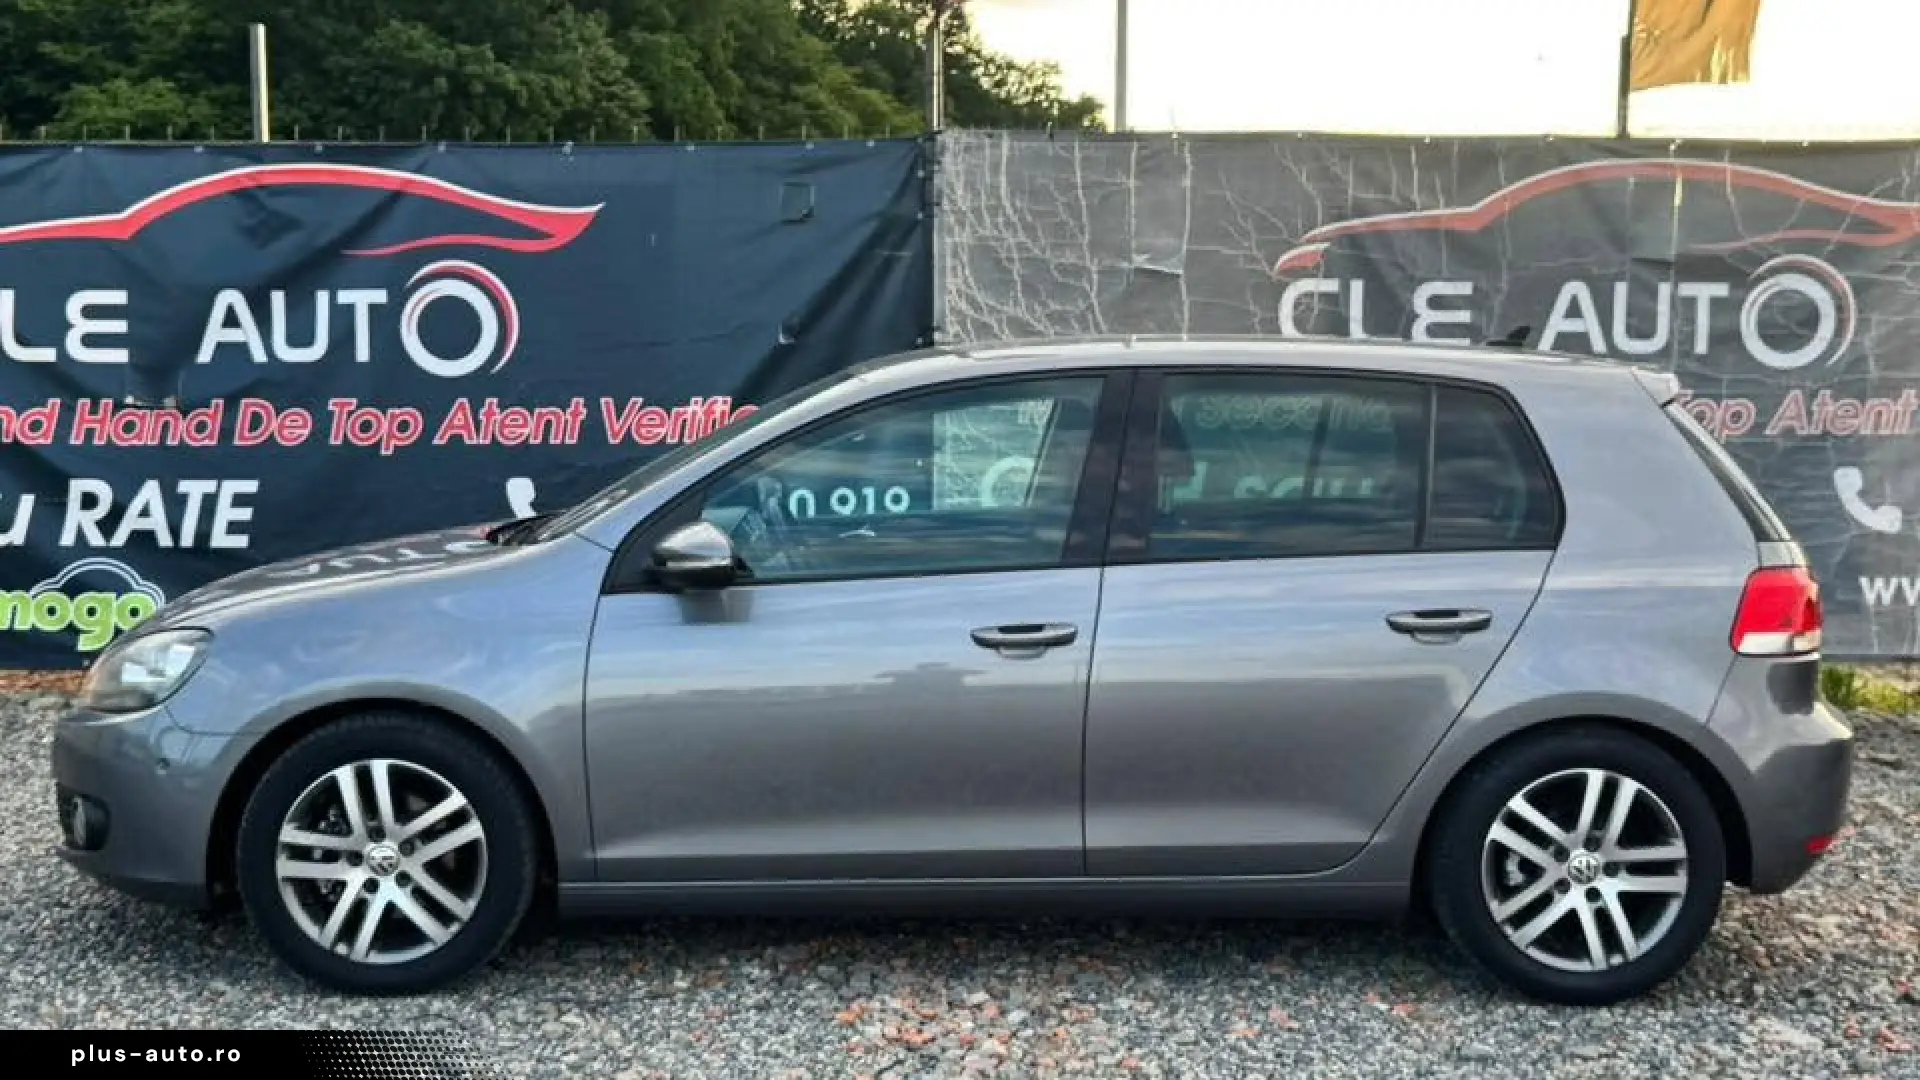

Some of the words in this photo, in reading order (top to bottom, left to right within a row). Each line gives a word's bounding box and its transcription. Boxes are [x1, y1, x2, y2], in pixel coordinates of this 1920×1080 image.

[196, 279, 499, 378] AUTO
[1538, 273, 1836, 370] AUTO
[69, 398, 224, 446] Hand
[234, 398, 312, 445] De
[329, 398, 423, 454] Top
[433, 398, 586, 445] Atent
[1765, 389, 1919, 435] Atent
[58, 478, 260, 549] RATE
